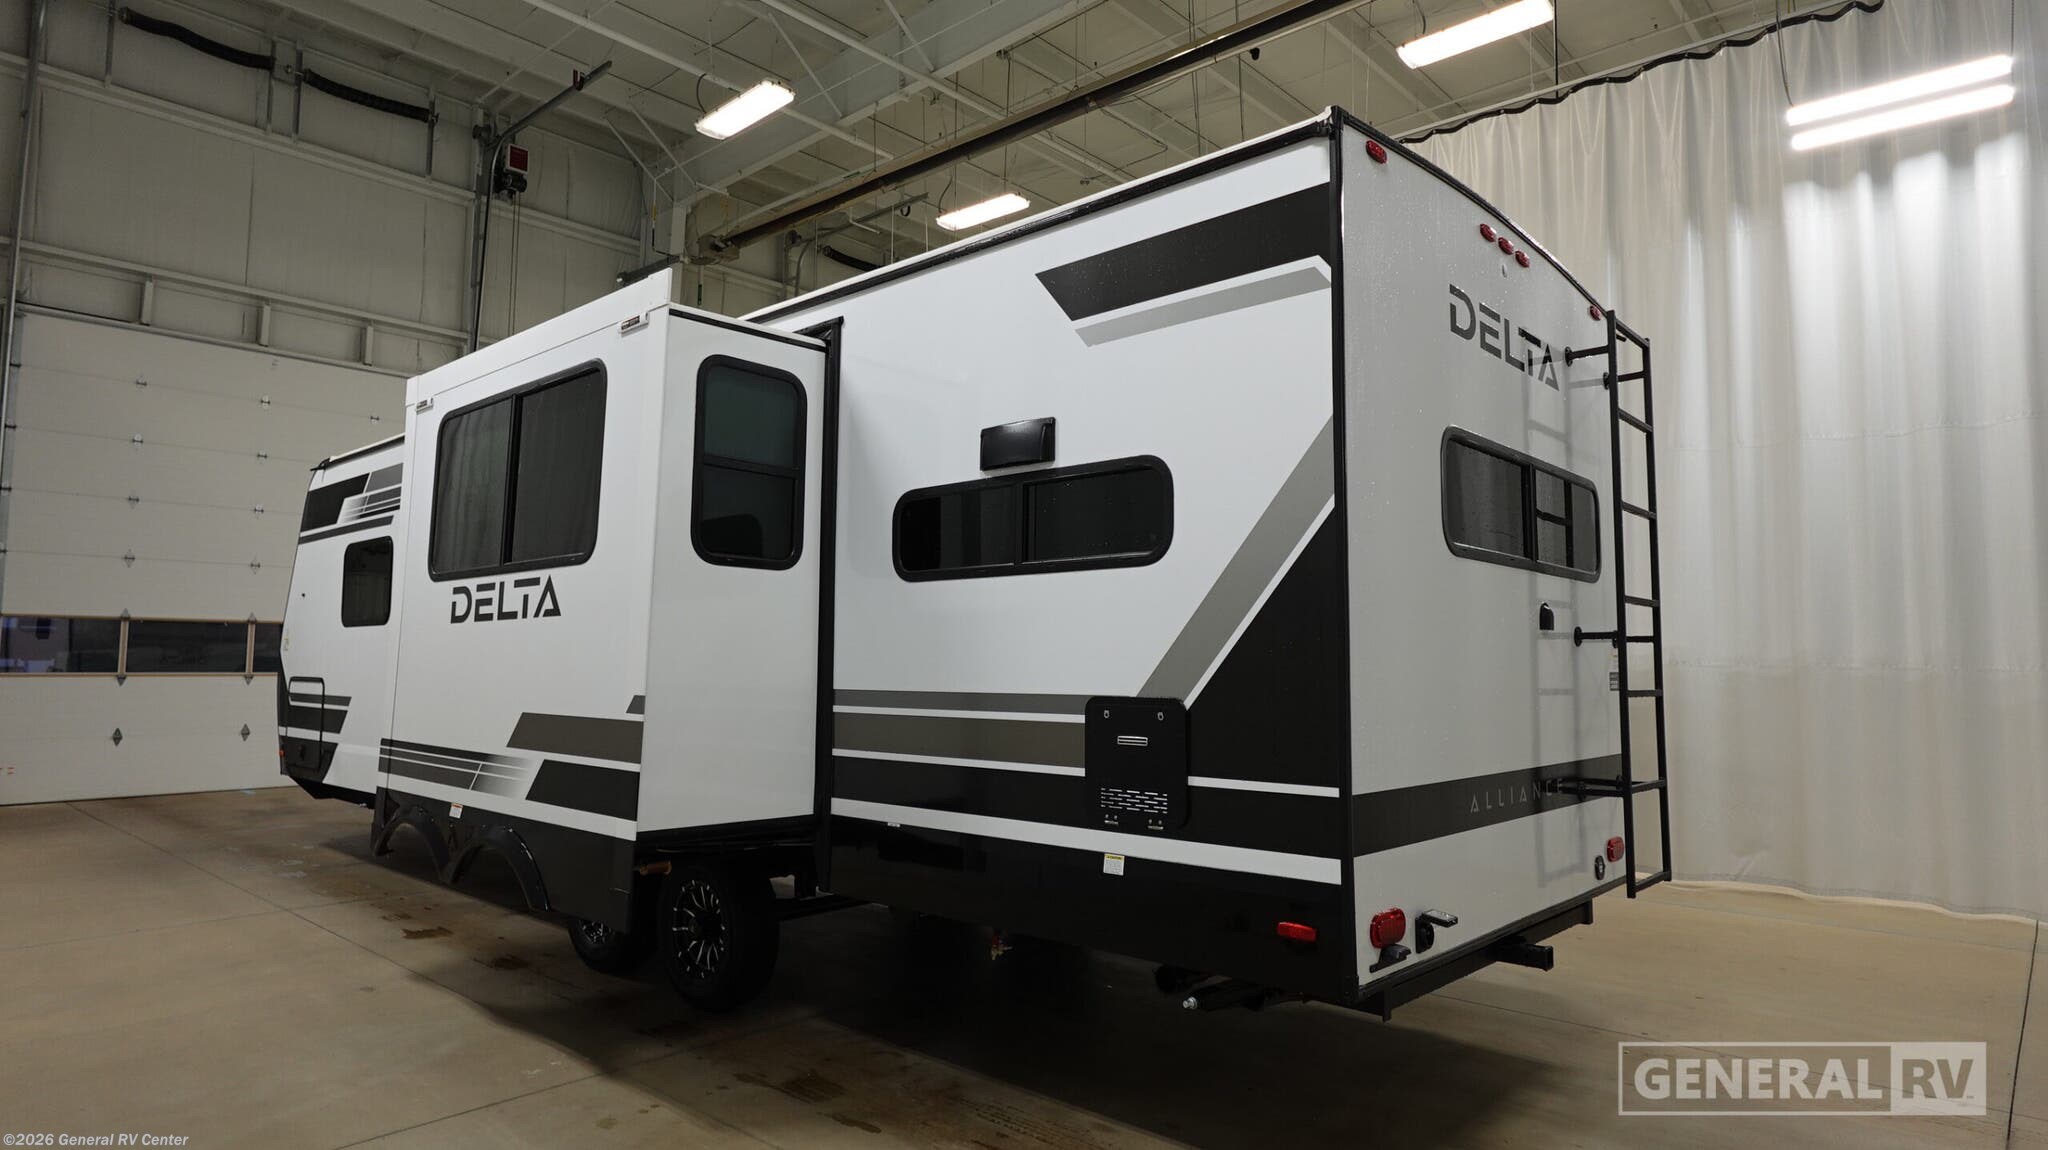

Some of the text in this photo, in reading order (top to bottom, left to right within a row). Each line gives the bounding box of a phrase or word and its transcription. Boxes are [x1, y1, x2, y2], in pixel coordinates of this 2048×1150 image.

[1449, 283, 1560, 392] DELTA
[450, 574, 562, 624] DELTA
[1470, 777, 1564, 814] ALLIANCE
